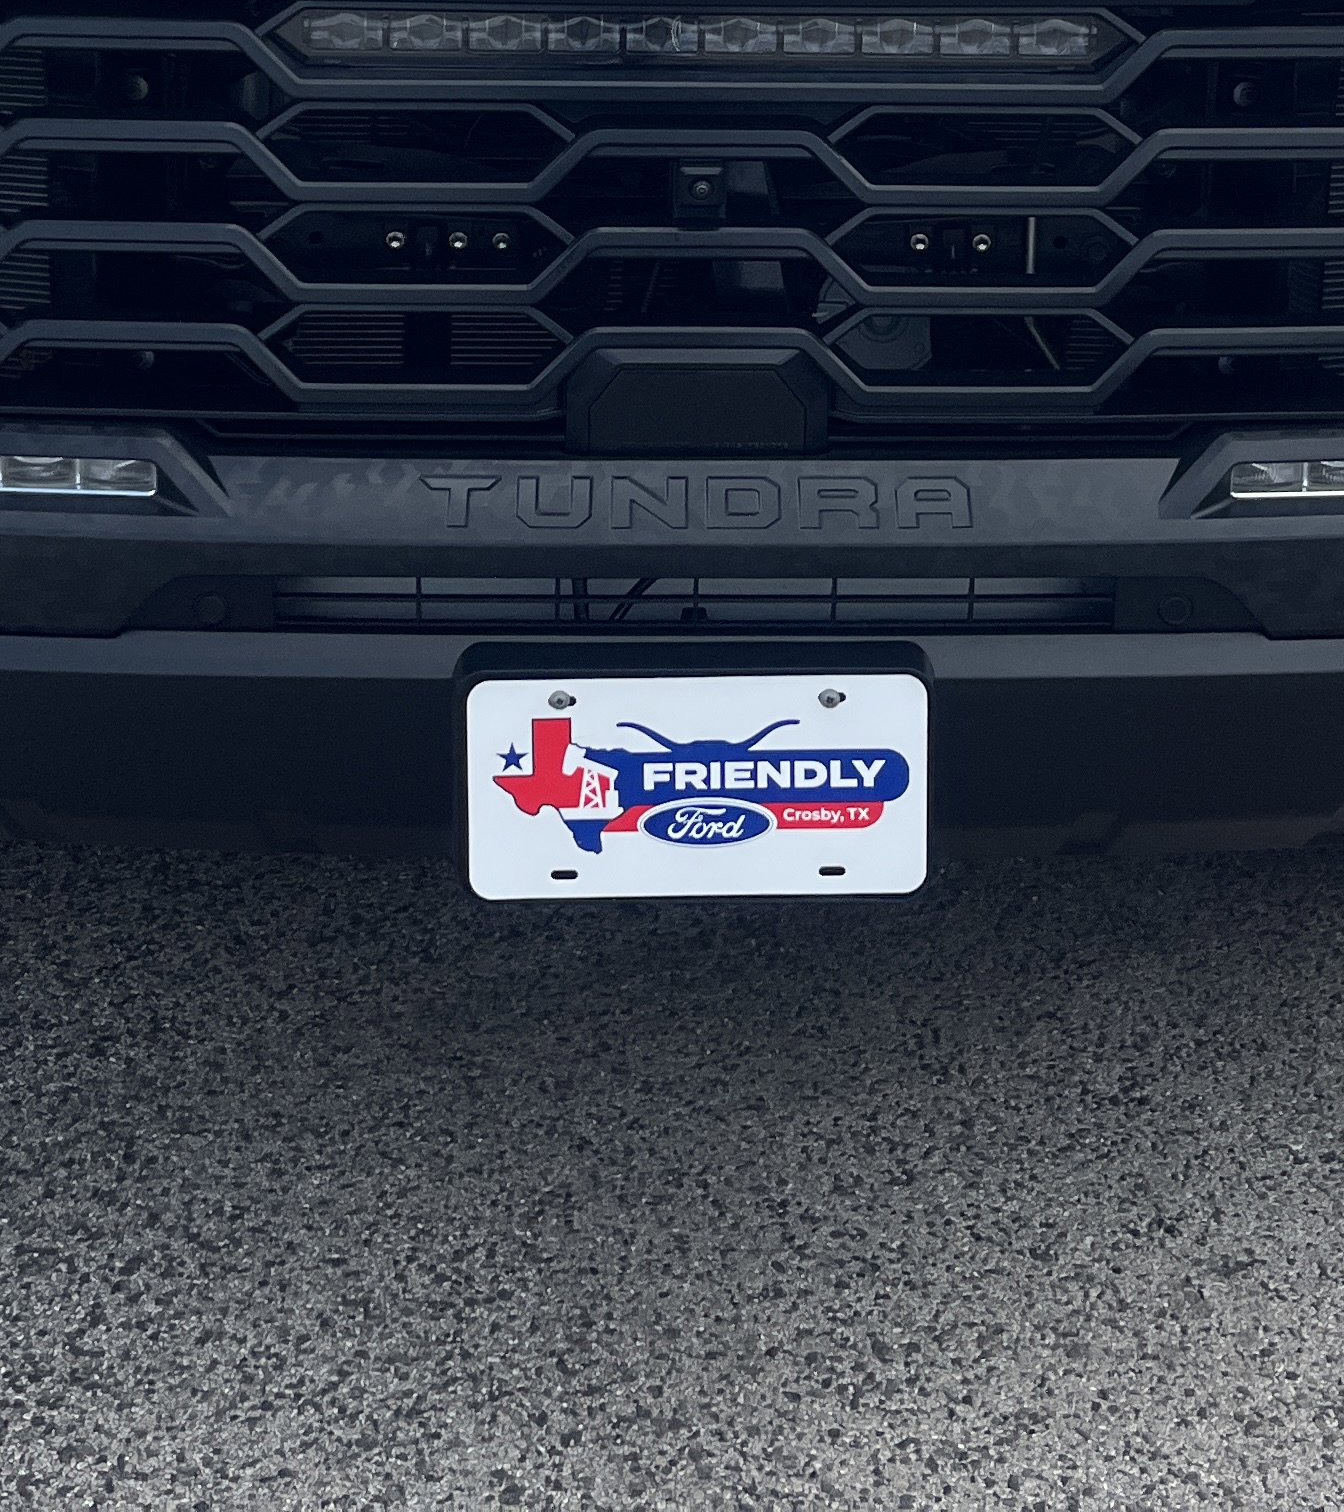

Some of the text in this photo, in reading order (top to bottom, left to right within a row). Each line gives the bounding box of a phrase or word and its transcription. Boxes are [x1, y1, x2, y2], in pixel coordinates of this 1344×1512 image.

[419, 474, 974, 530] TUNDRA
[642, 758, 887, 791] FRIENDLY
[666, 807, 746, 841] Ford
[782, 807, 870, 824] Crosby, TX
